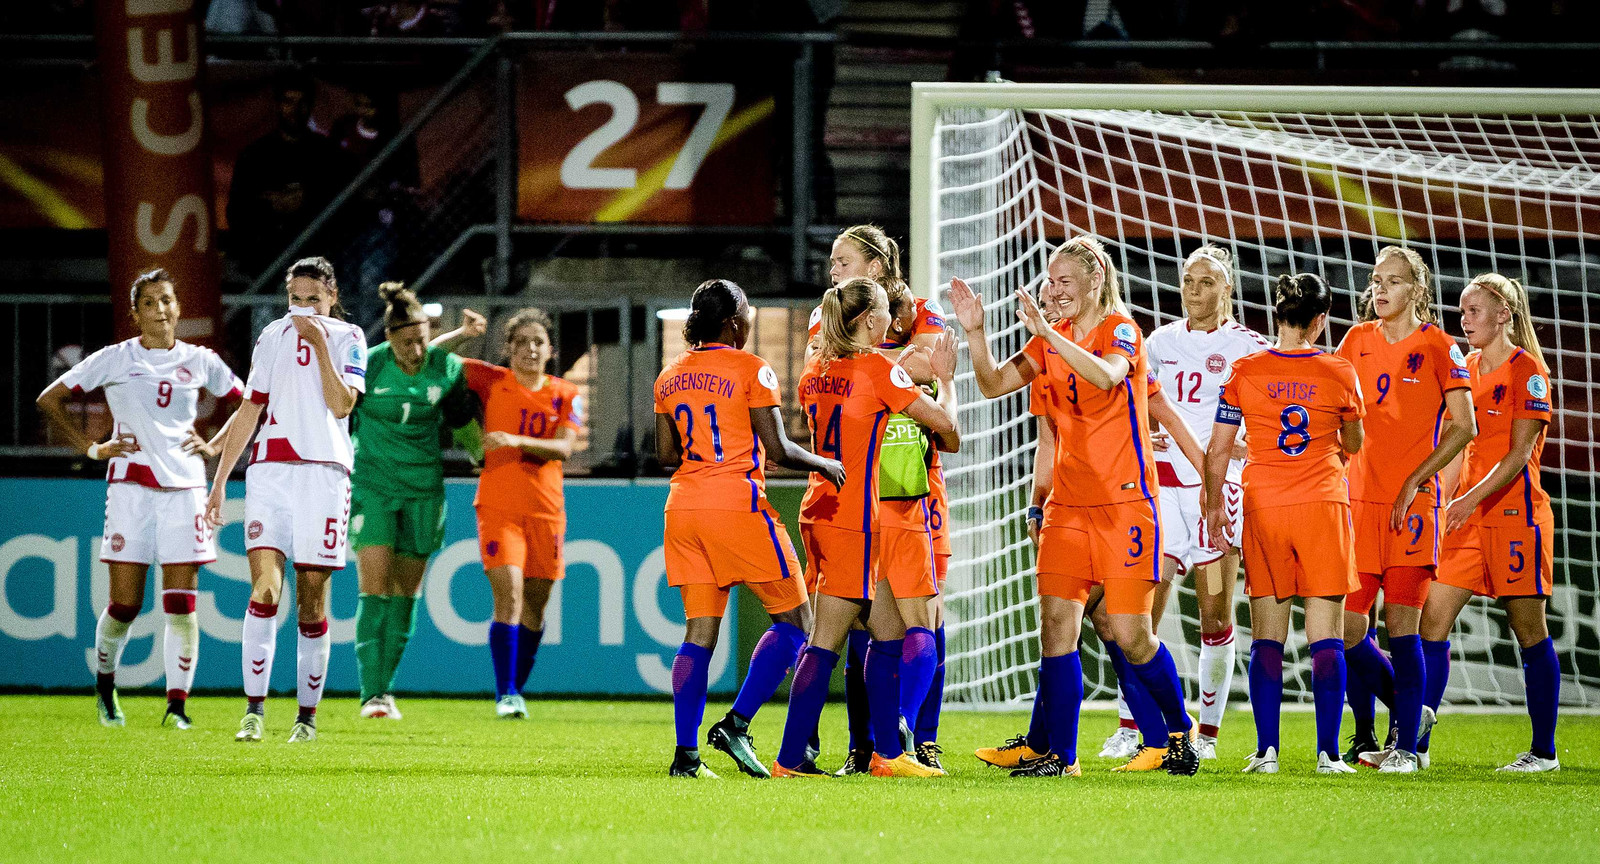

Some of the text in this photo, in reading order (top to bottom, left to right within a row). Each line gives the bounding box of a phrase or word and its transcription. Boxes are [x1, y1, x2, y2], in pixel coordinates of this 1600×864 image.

[560, 79, 736, 189] 27
[296, 334, 311, 367] 5
[156, 380, 173, 408] 9
[659, 372, 736, 401] BEERENSTEYN
[804, 376, 855, 398] GROENEN
[1066, 372, 1078, 405] 3
[1174, 370, 1203, 404] 12
[1267, 381, 1318, 402] SPITSE
[1376, 373, 1391, 405] 9
[401, 402, 411, 424] 1
[518, 408, 547, 438] 10
[674, 402, 725, 463] 21
[808, 402, 844, 462] 14
[883, 423, 920, 441] SPE
[1277, 404, 1312, 457] 8
[194, 513, 205, 544] 9
[930, 498, 942, 531] 6
[1406, 513, 1424, 546] 9
[323, 517, 338, 550] 5
[1126, 525, 1143, 558] 3
[1508, 540, 1525, 574] 5
